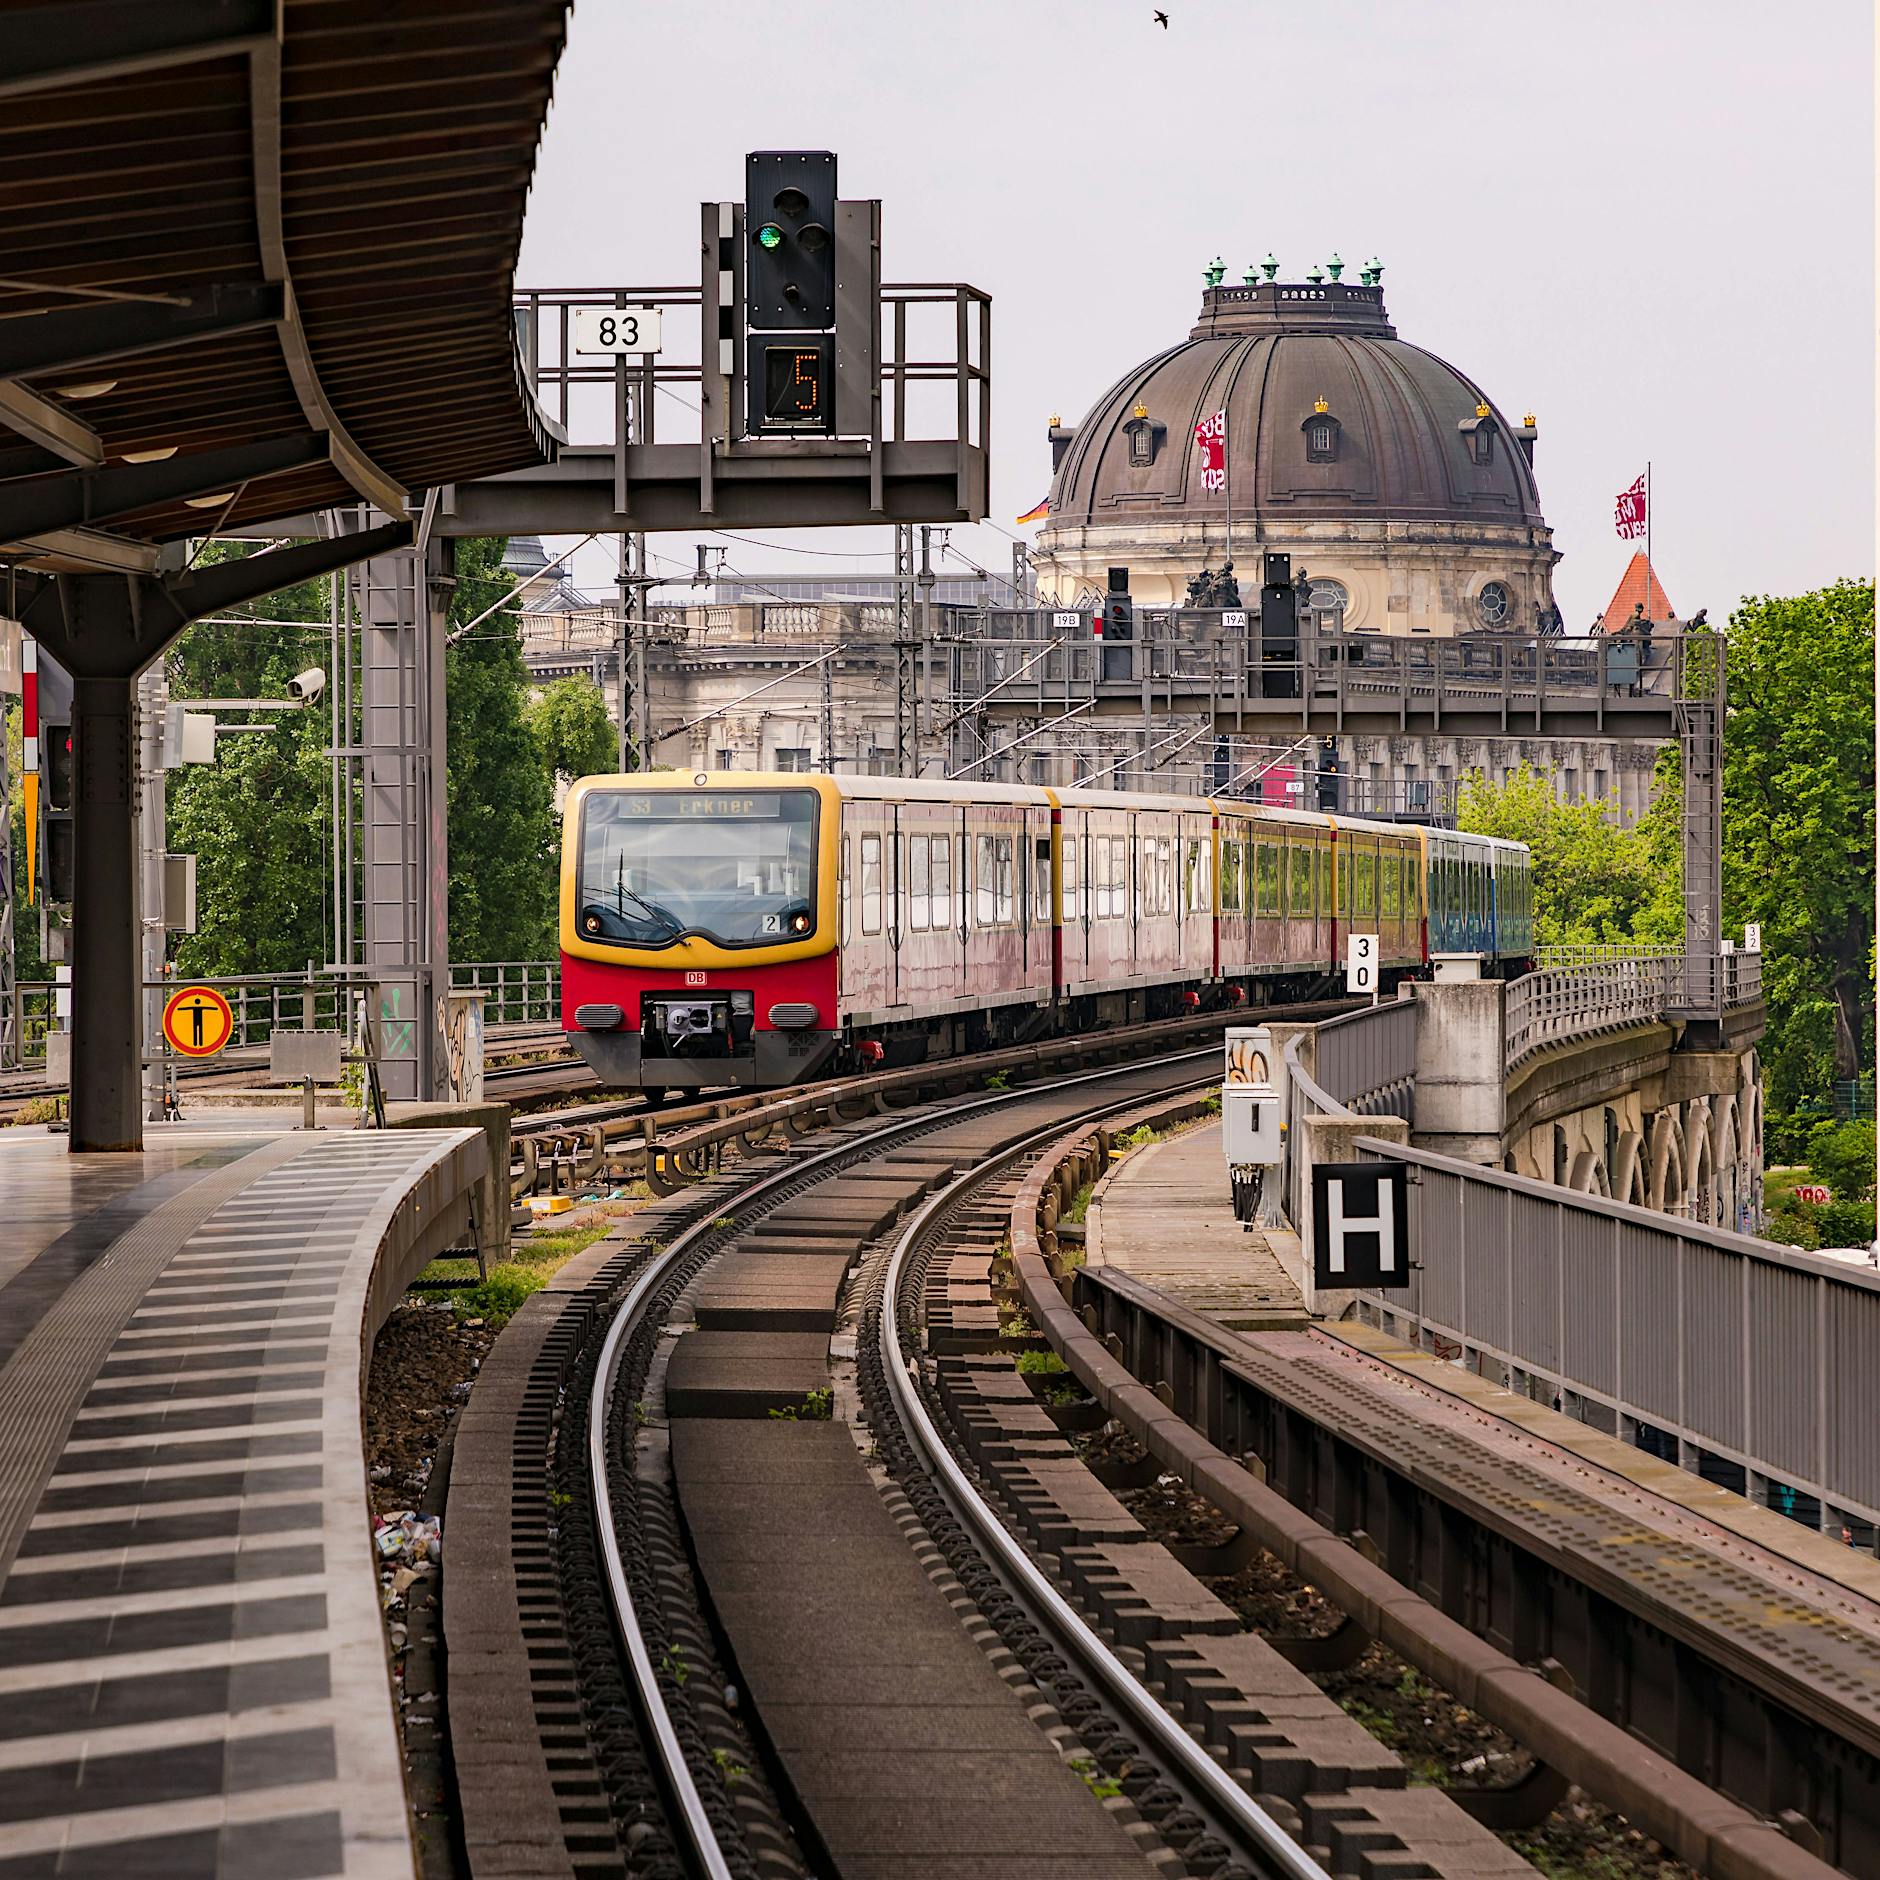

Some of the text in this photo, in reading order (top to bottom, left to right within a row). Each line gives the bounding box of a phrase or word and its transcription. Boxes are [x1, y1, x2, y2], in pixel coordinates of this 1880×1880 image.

[600, 317, 638, 346] 83
[796, 355, 817, 410] 5
[1058, 615, 1076, 625] 19B
[1226, 614, 1245, 625] 19A
[1326, 735, 1333, 749] 5
[631, 799, 754, 815] S3 Erkner
[766, 916, 776, 932] 2
[688, 972, 704, 983] DB
[1327, 1178, 1395, 1272] H
